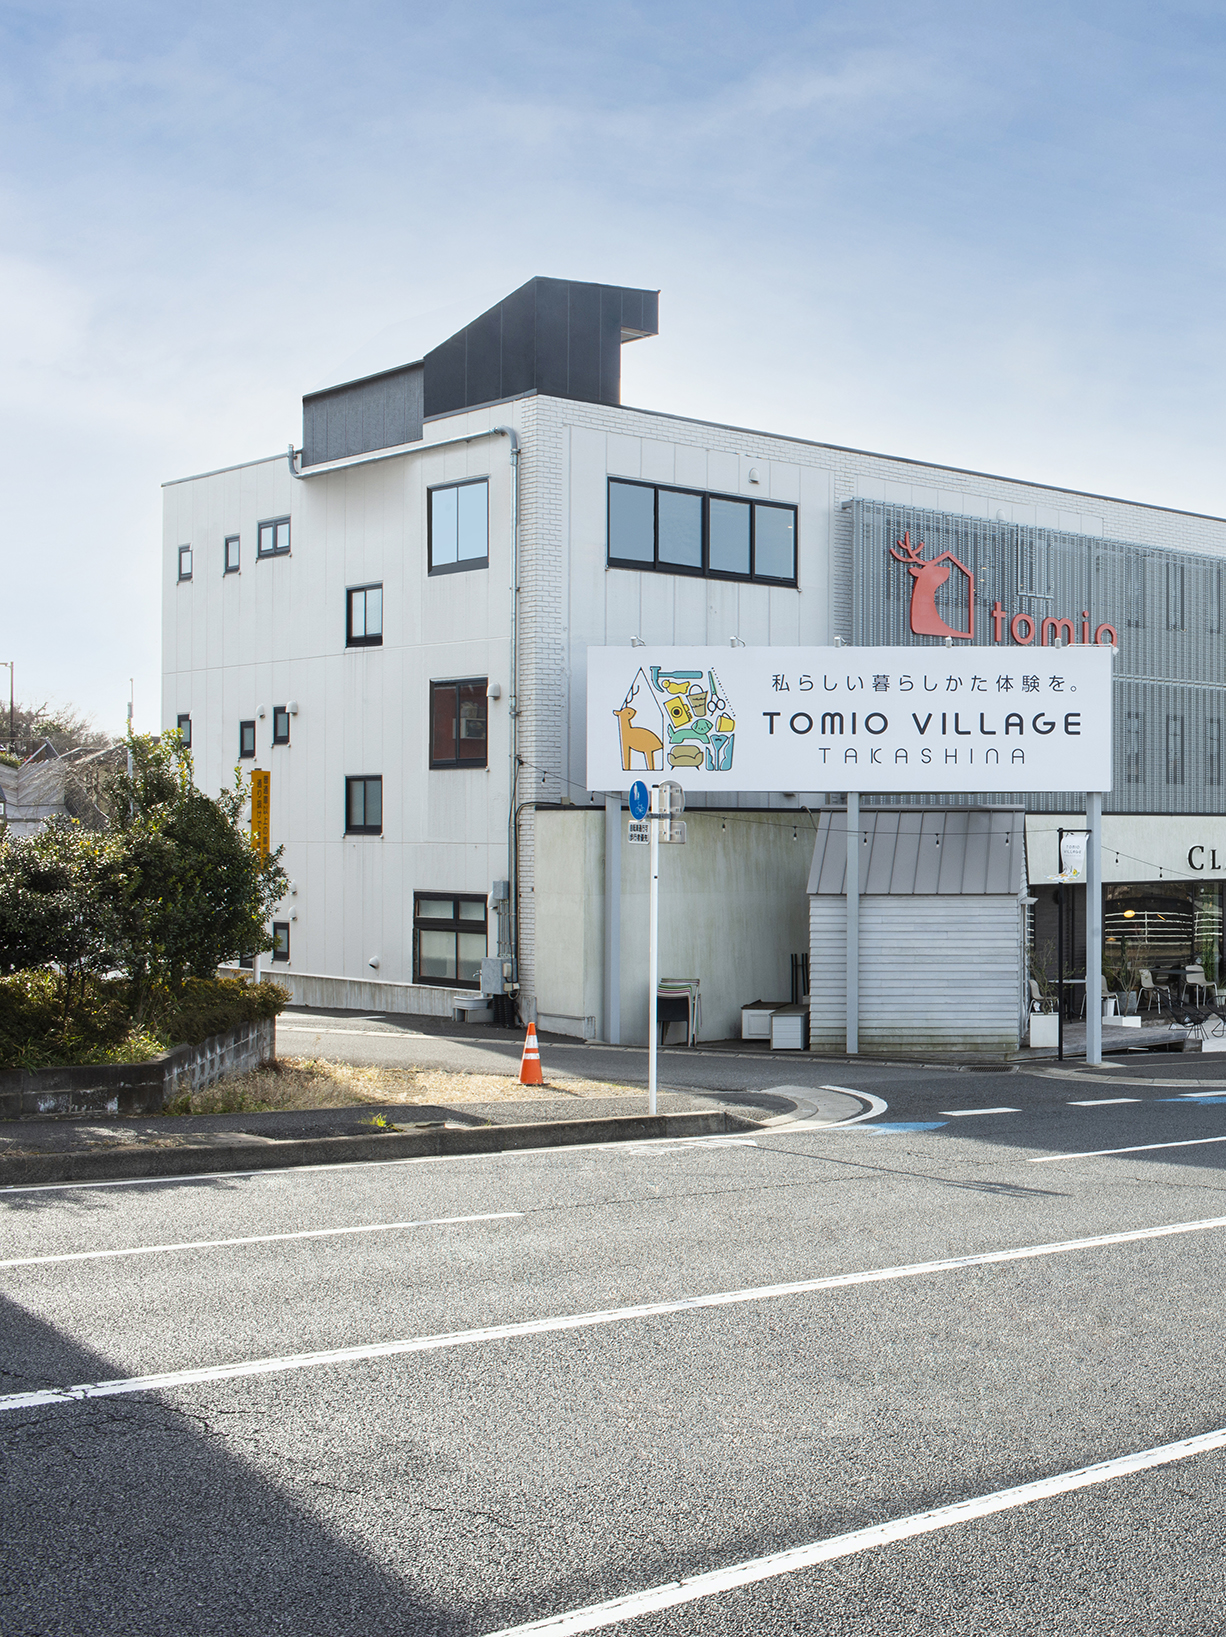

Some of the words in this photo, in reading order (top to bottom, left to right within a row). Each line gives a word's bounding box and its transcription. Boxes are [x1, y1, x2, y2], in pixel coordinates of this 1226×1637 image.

[991, 601, 1118, 647] tomio
[771, 673, 1077, 694] 私らしい暮らしかた体験を。
[762, 711, 889, 736] TOMIO
[911, 711, 1081, 736] VILLAGE
[818, 747, 1026, 765] TAKASHINA
